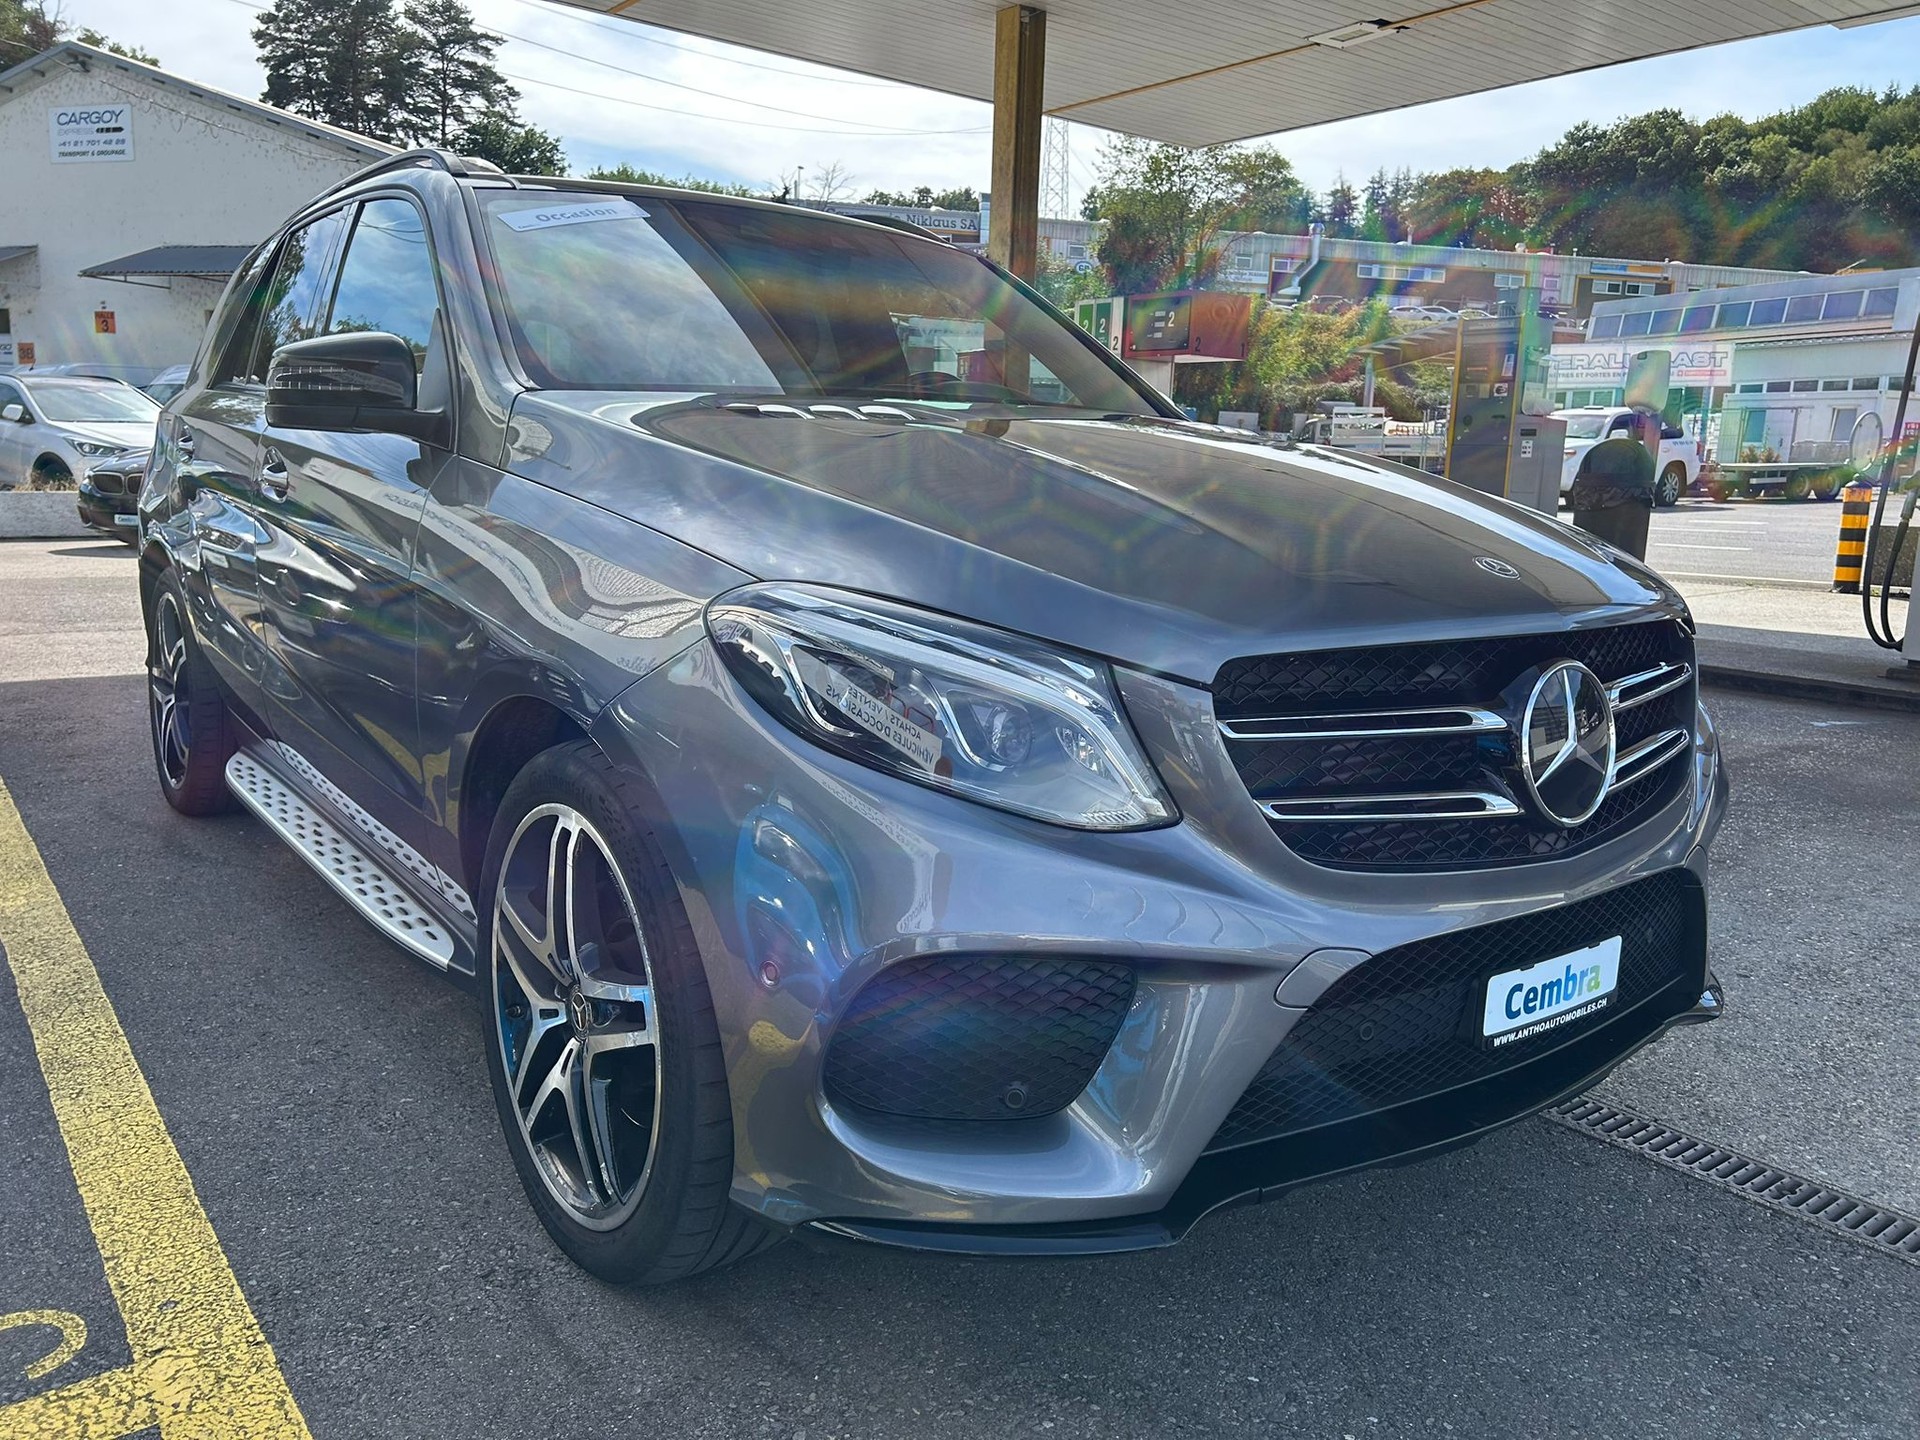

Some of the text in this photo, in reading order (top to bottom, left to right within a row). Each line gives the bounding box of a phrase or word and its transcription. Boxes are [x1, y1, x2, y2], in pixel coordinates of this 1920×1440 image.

[57, 109, 124, 126] CARGOY
[58, 150, 90, 158] TRANSPORT
[535, 207, 618, 222] Occasion
[906, 214, 978, 231] Niklaus SA
[101, 319, 109, 332] 3
[1083, 319, 1089, 330] 2
[1099, 318, 1106, 333] 2
[1168, 311, 1175, 327] 2
[1112, 336, 1119, 350] 2
[1195, 336, 1201, 351] 2
[1505, 964, 1601, 1020] Cembra
[1493, 997, 1607, 1047] WWW.ANTHOAUTOMOBILES.CH
